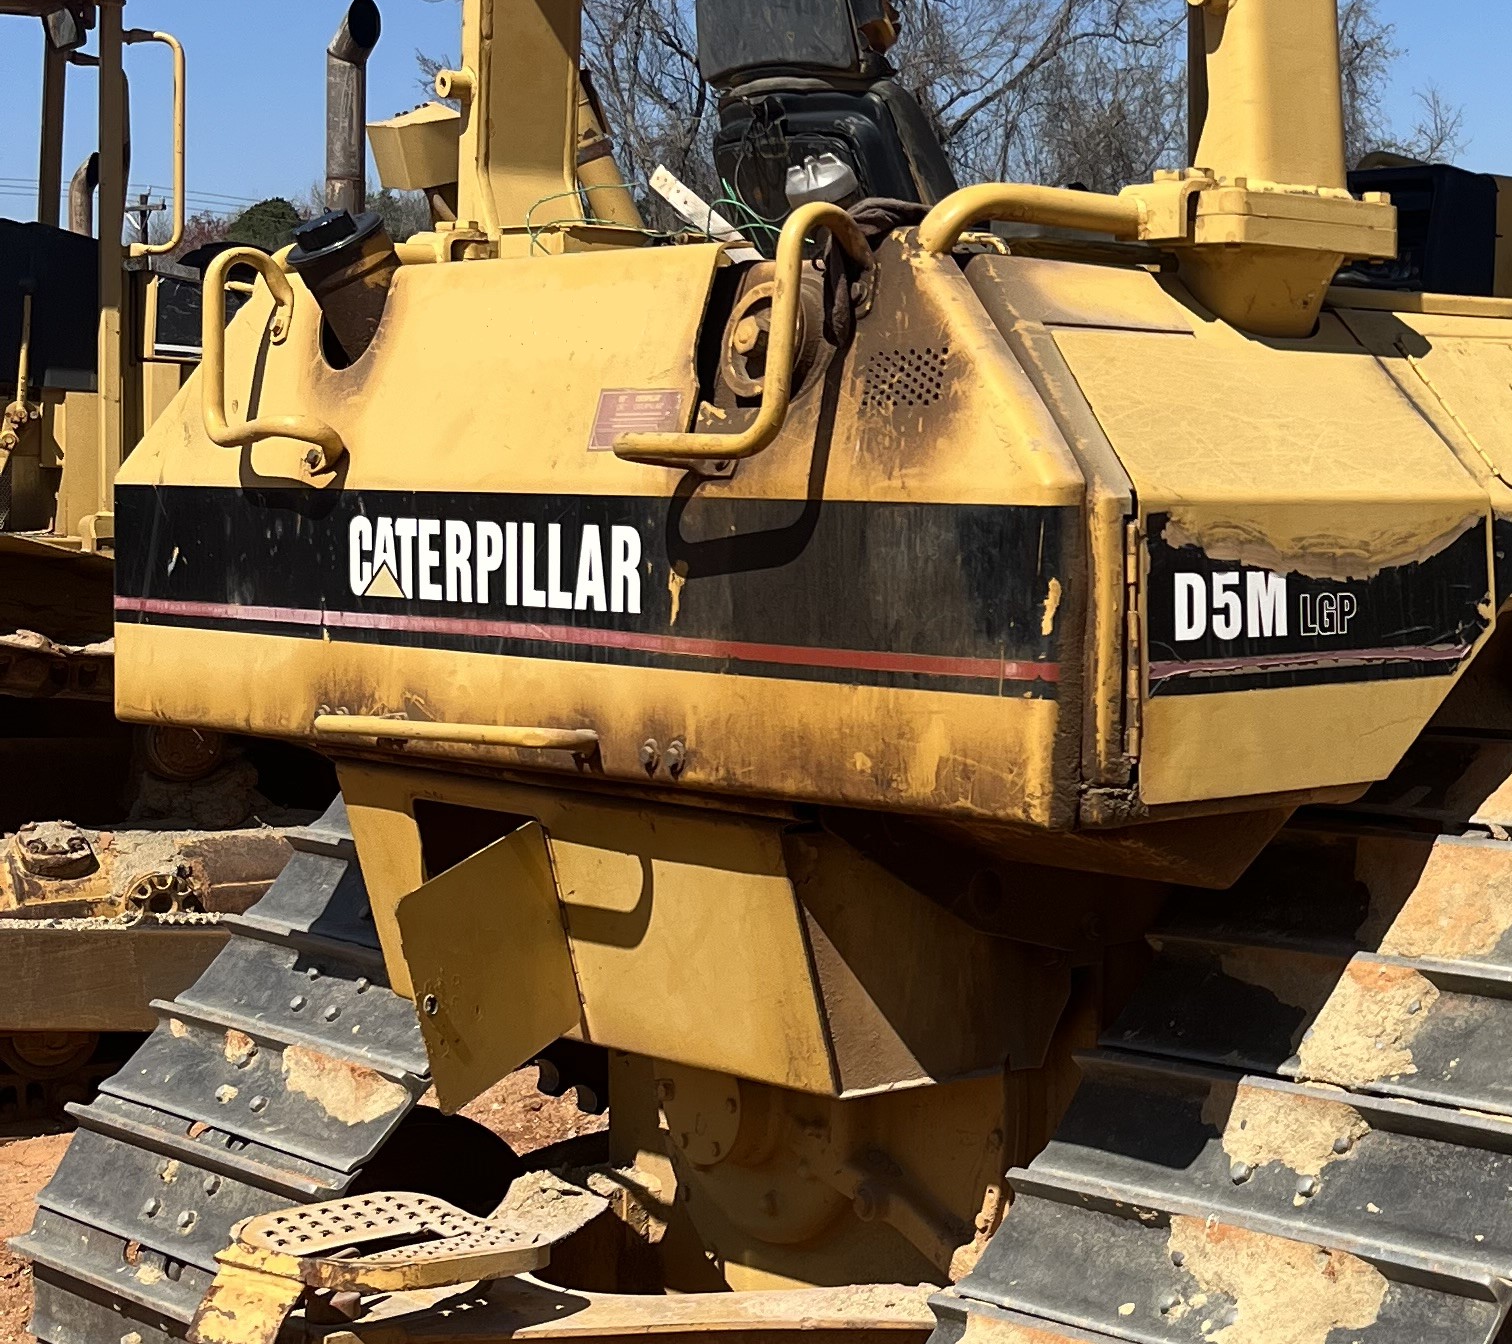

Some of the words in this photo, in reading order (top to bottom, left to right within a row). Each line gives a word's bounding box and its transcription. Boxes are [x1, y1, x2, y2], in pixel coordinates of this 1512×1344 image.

[349, 515, 642, 614] CATERPILLAR
[1174, 571, 1288, 641] D5M
[1299, 592, 1357, 637] LGP
